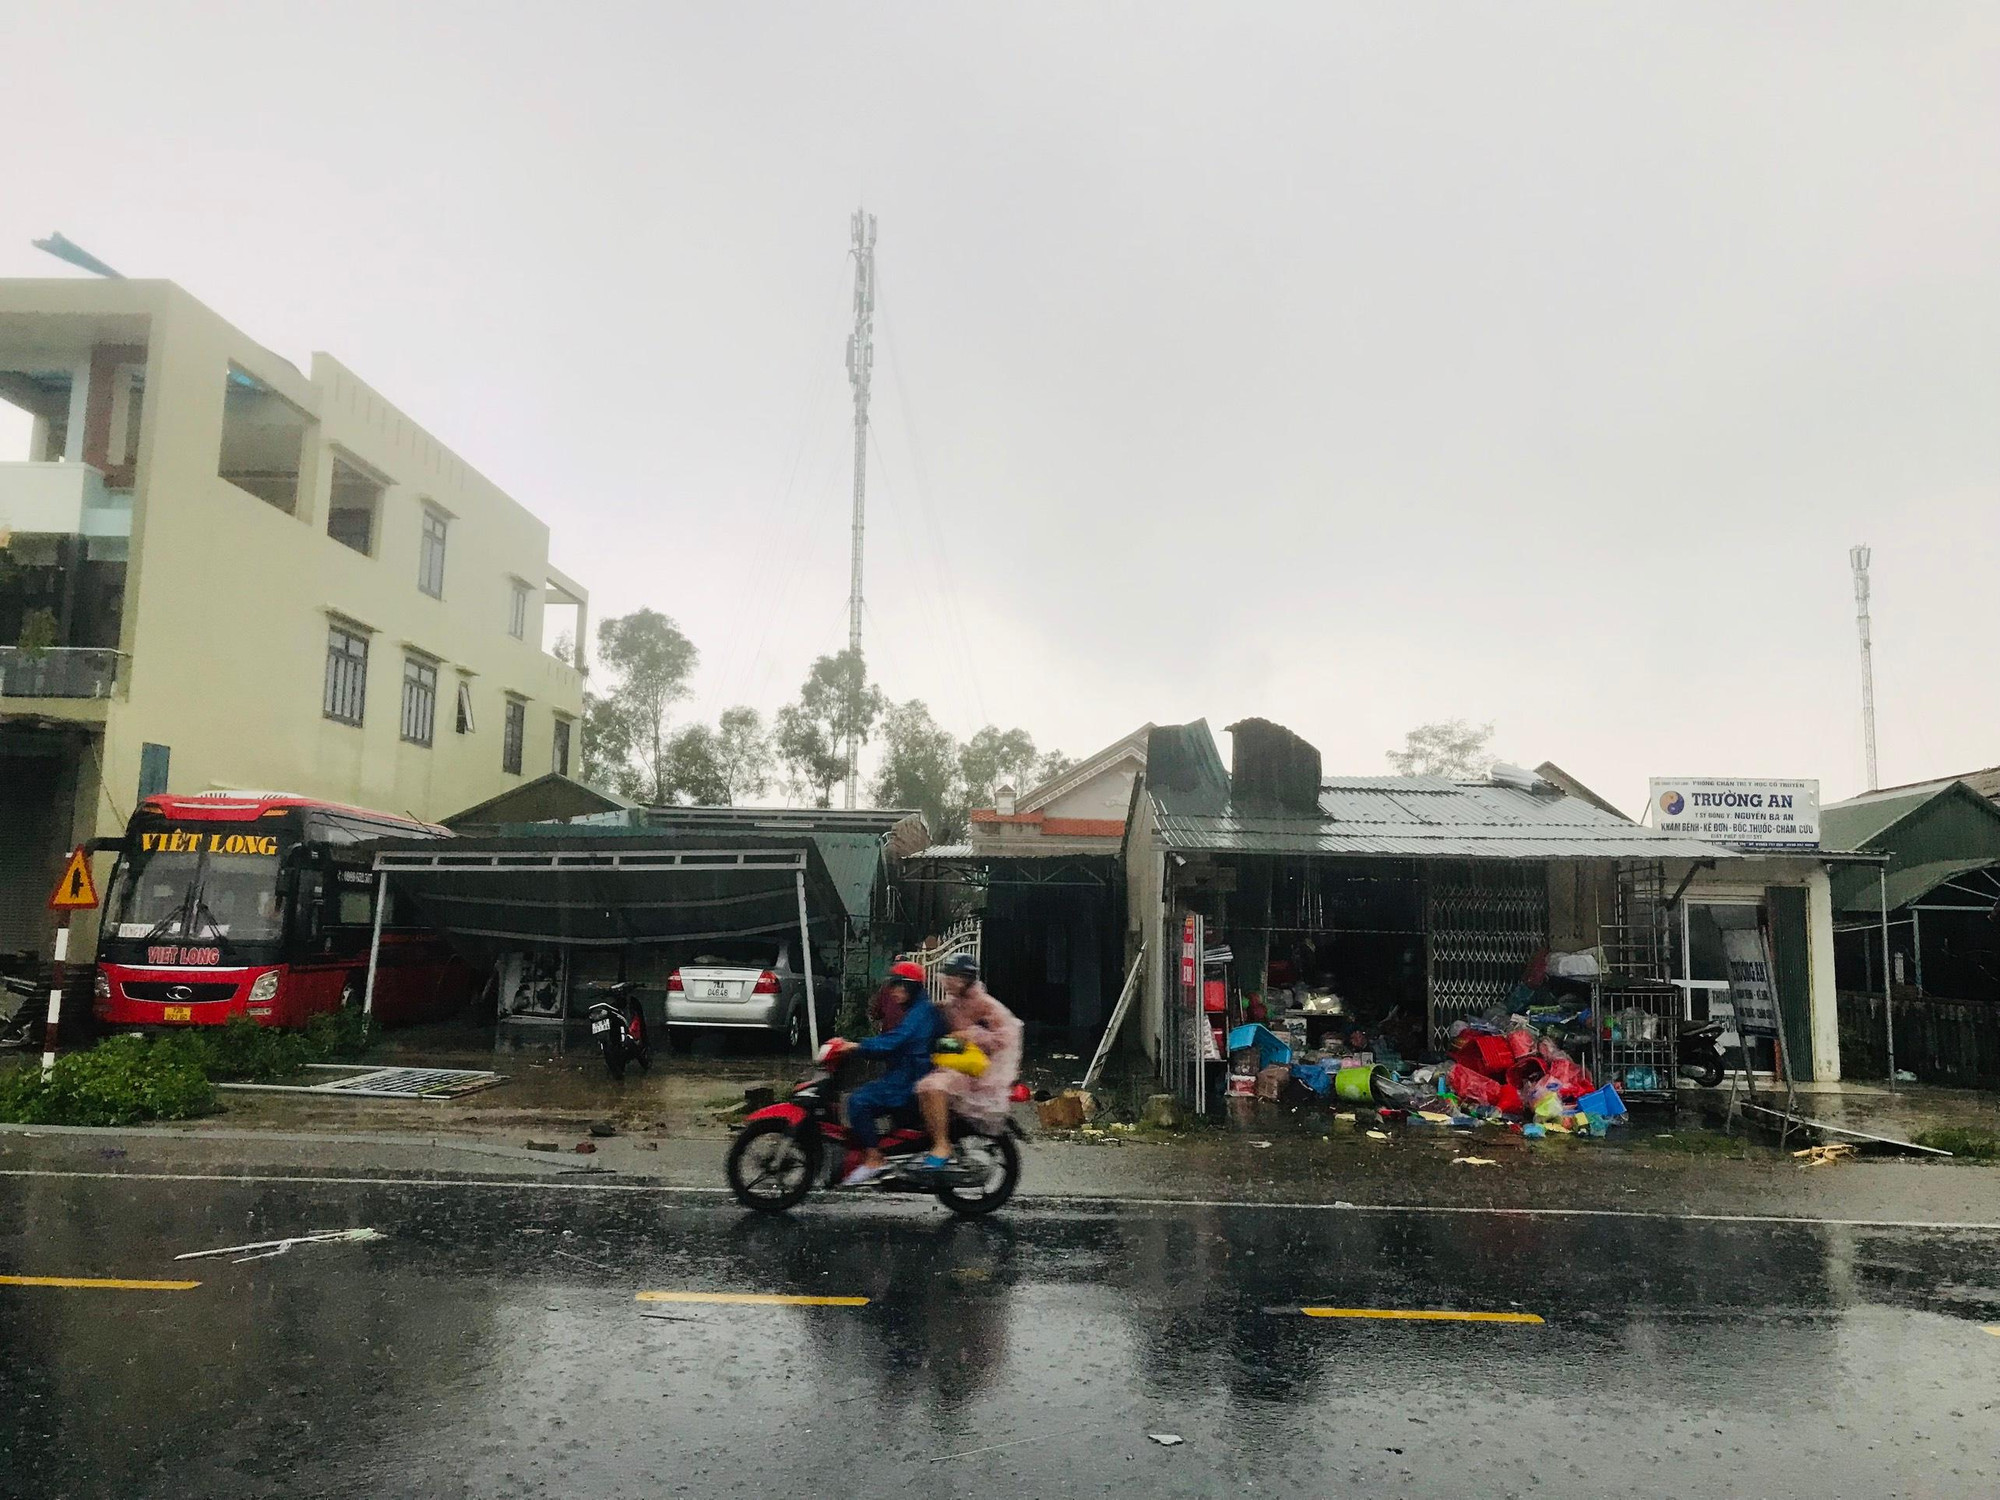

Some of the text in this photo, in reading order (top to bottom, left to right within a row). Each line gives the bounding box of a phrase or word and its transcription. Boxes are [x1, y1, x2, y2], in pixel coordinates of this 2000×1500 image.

[1691, 790, 1793, 808] TRƯỜNG AN
[1783, 813, 1794, 821] AN
[208, 834, 278, 855] LONG
[180, 947, 220, 965] LONG
